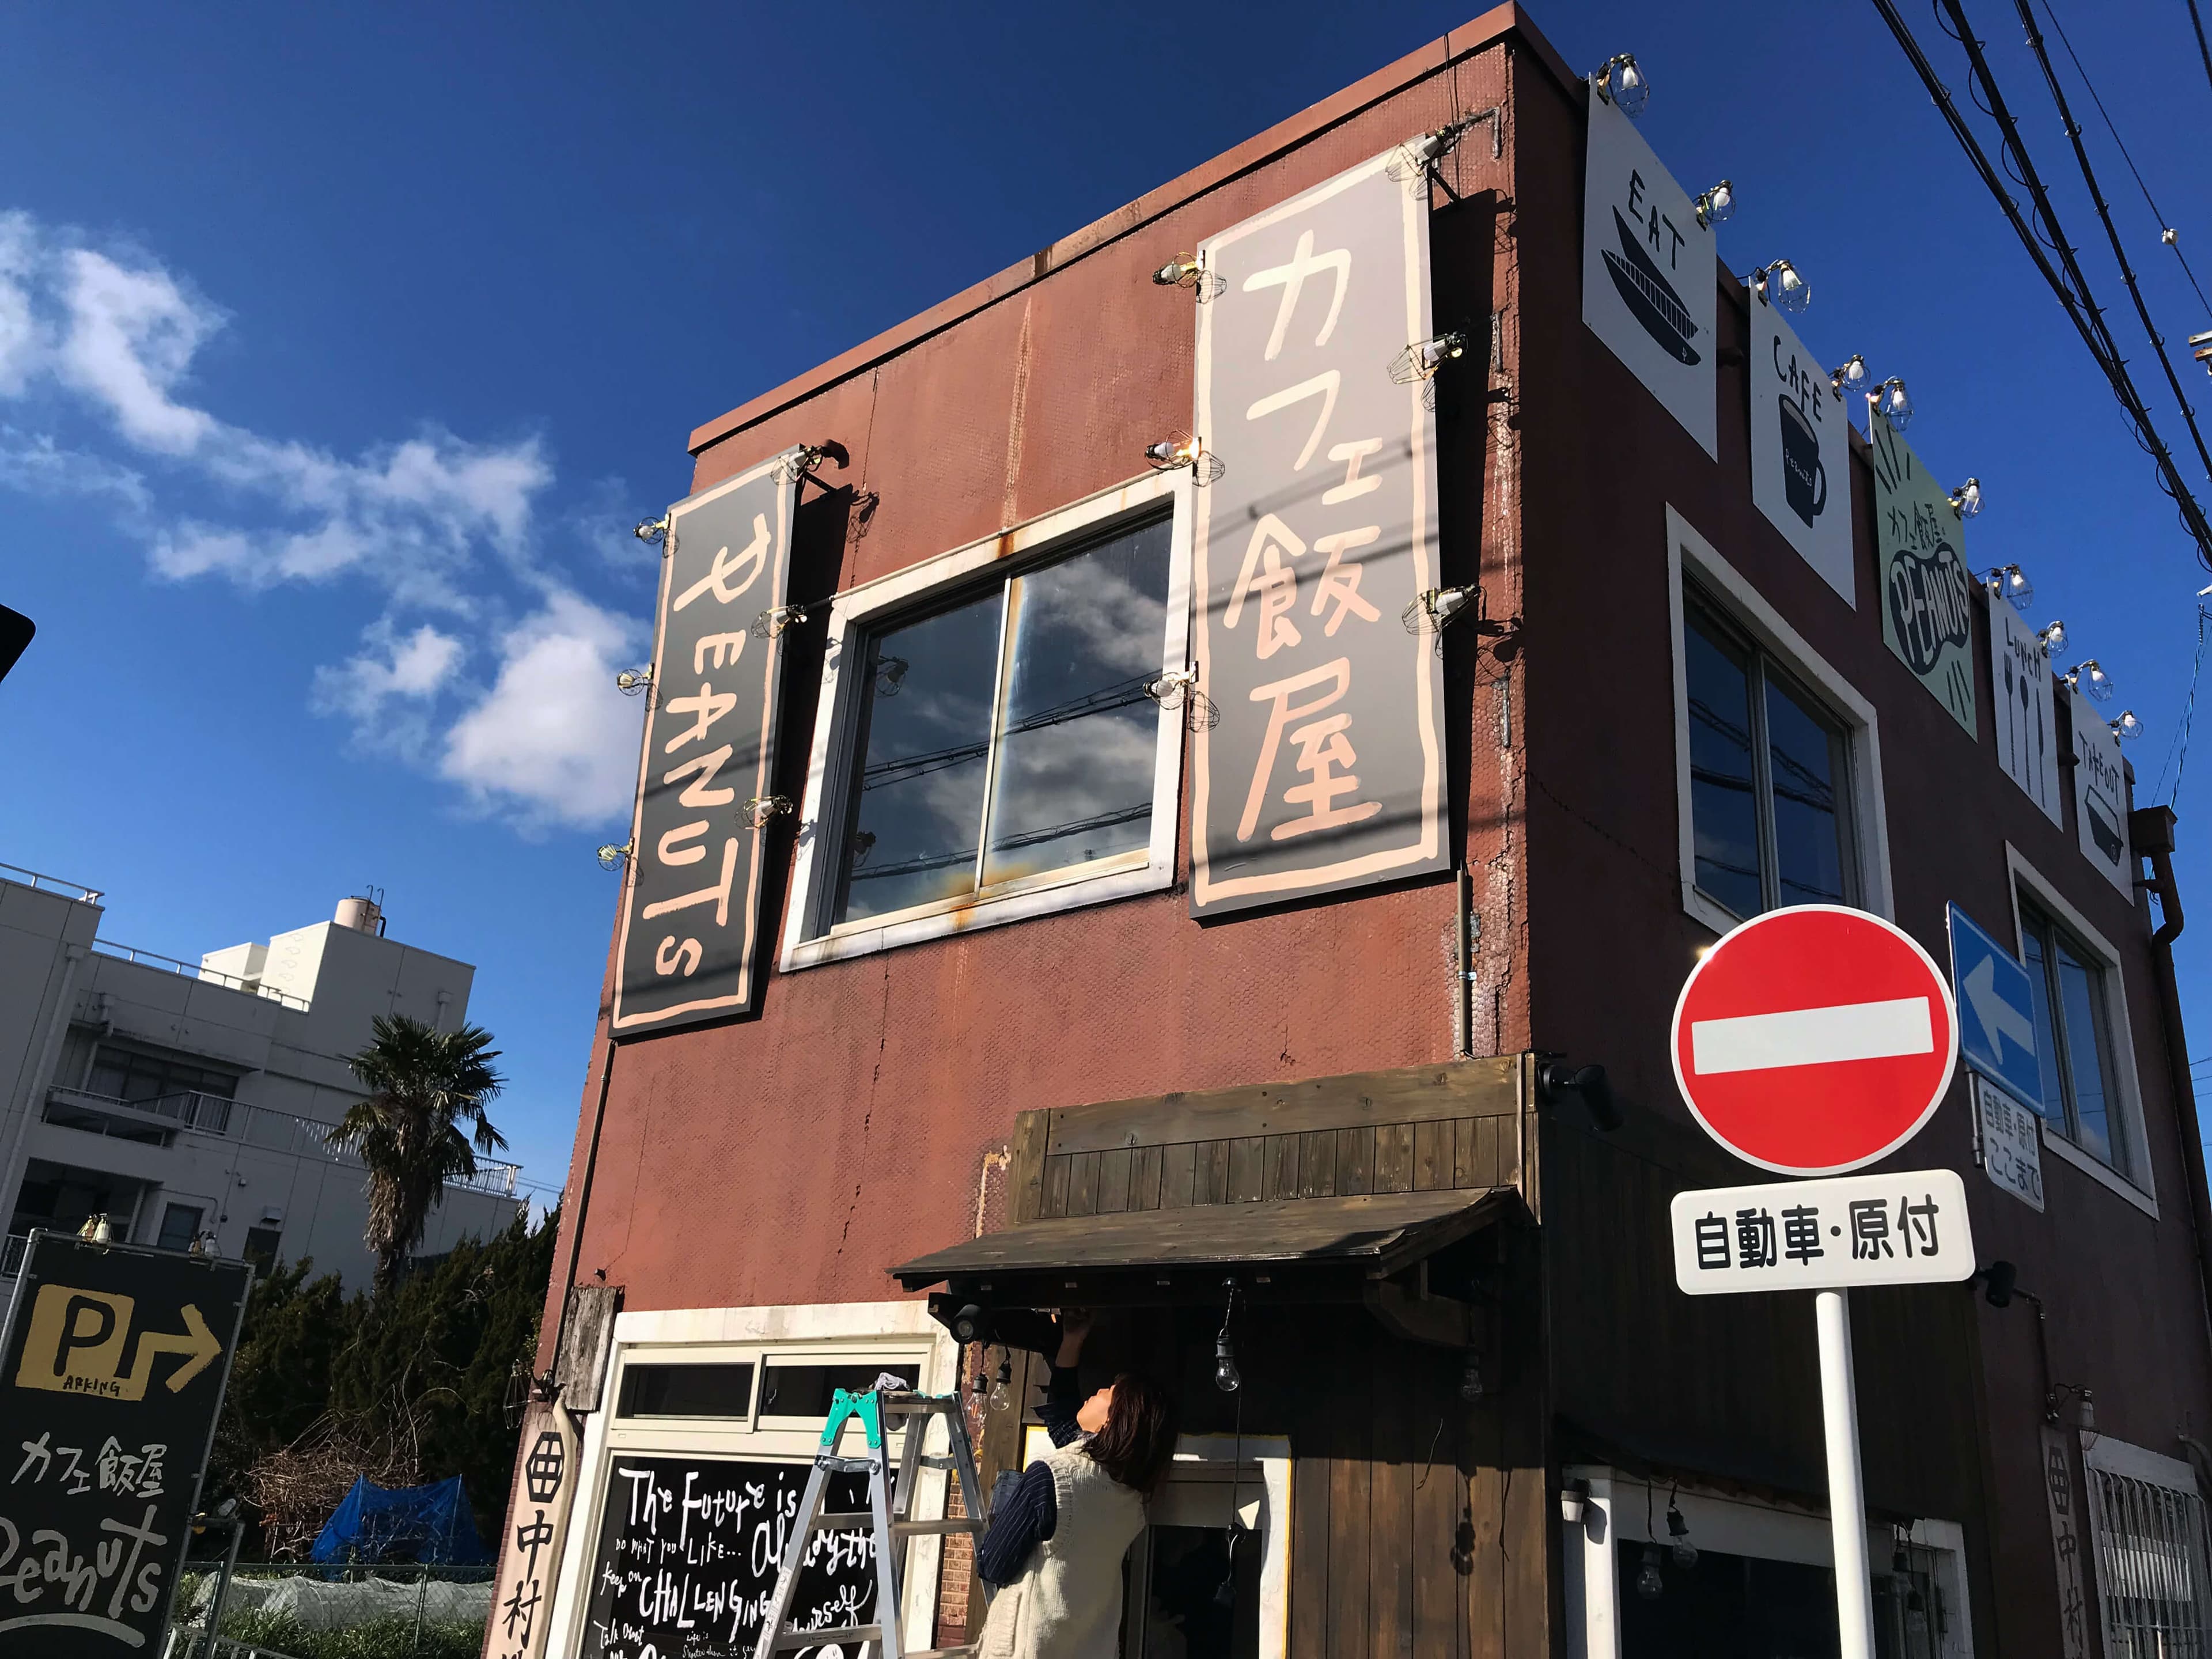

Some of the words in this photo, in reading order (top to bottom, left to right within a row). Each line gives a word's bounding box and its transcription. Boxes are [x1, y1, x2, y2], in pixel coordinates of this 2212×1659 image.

[1627, 169, 1685, 270] EAT
[1772, 335, 1823, 422] CAFE
[1222, 228, 1384, 843] カフェ飯屋
[1891, 551, 1969, 666] PEANUTS
[2004, 616, 2041, 683] LUNCH
[1990, 1137, 2040, 1200] ここまで
[1695, 1193, 1940, 1270] 自動車・原付
[53, 1294, 115, 1377] P
[12, 1431, 168, 1498] カフェ飯屋
[618, 1467, 673, 1535] The
[680, 1471, 765, 1551] Future
[777, 1471, 796, 1517] is
